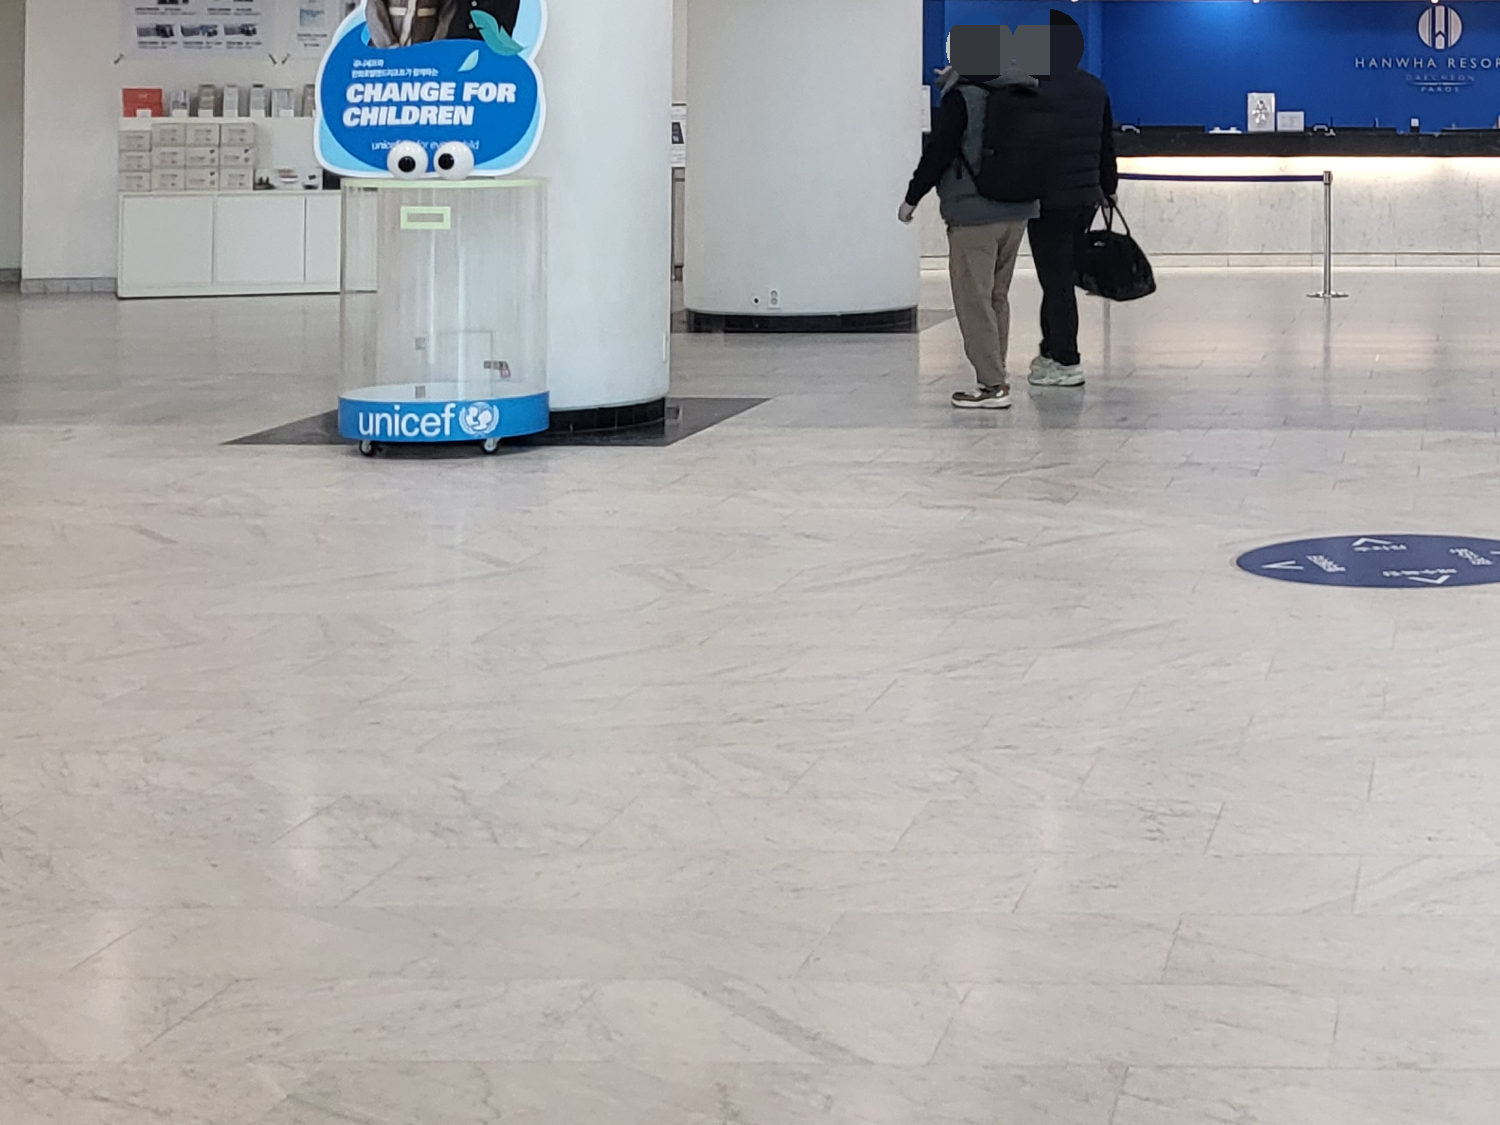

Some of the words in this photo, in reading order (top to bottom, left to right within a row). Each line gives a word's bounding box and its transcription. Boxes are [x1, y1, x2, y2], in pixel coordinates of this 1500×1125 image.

[1354, 57, 1437, 69] HANWHA
[346, 82, 456, 103] CHANGE
[462, 81, 517, 103] FOR
[342, 105, 475, 127] CHILDREN
[358, 402, 456, 438] unicef
